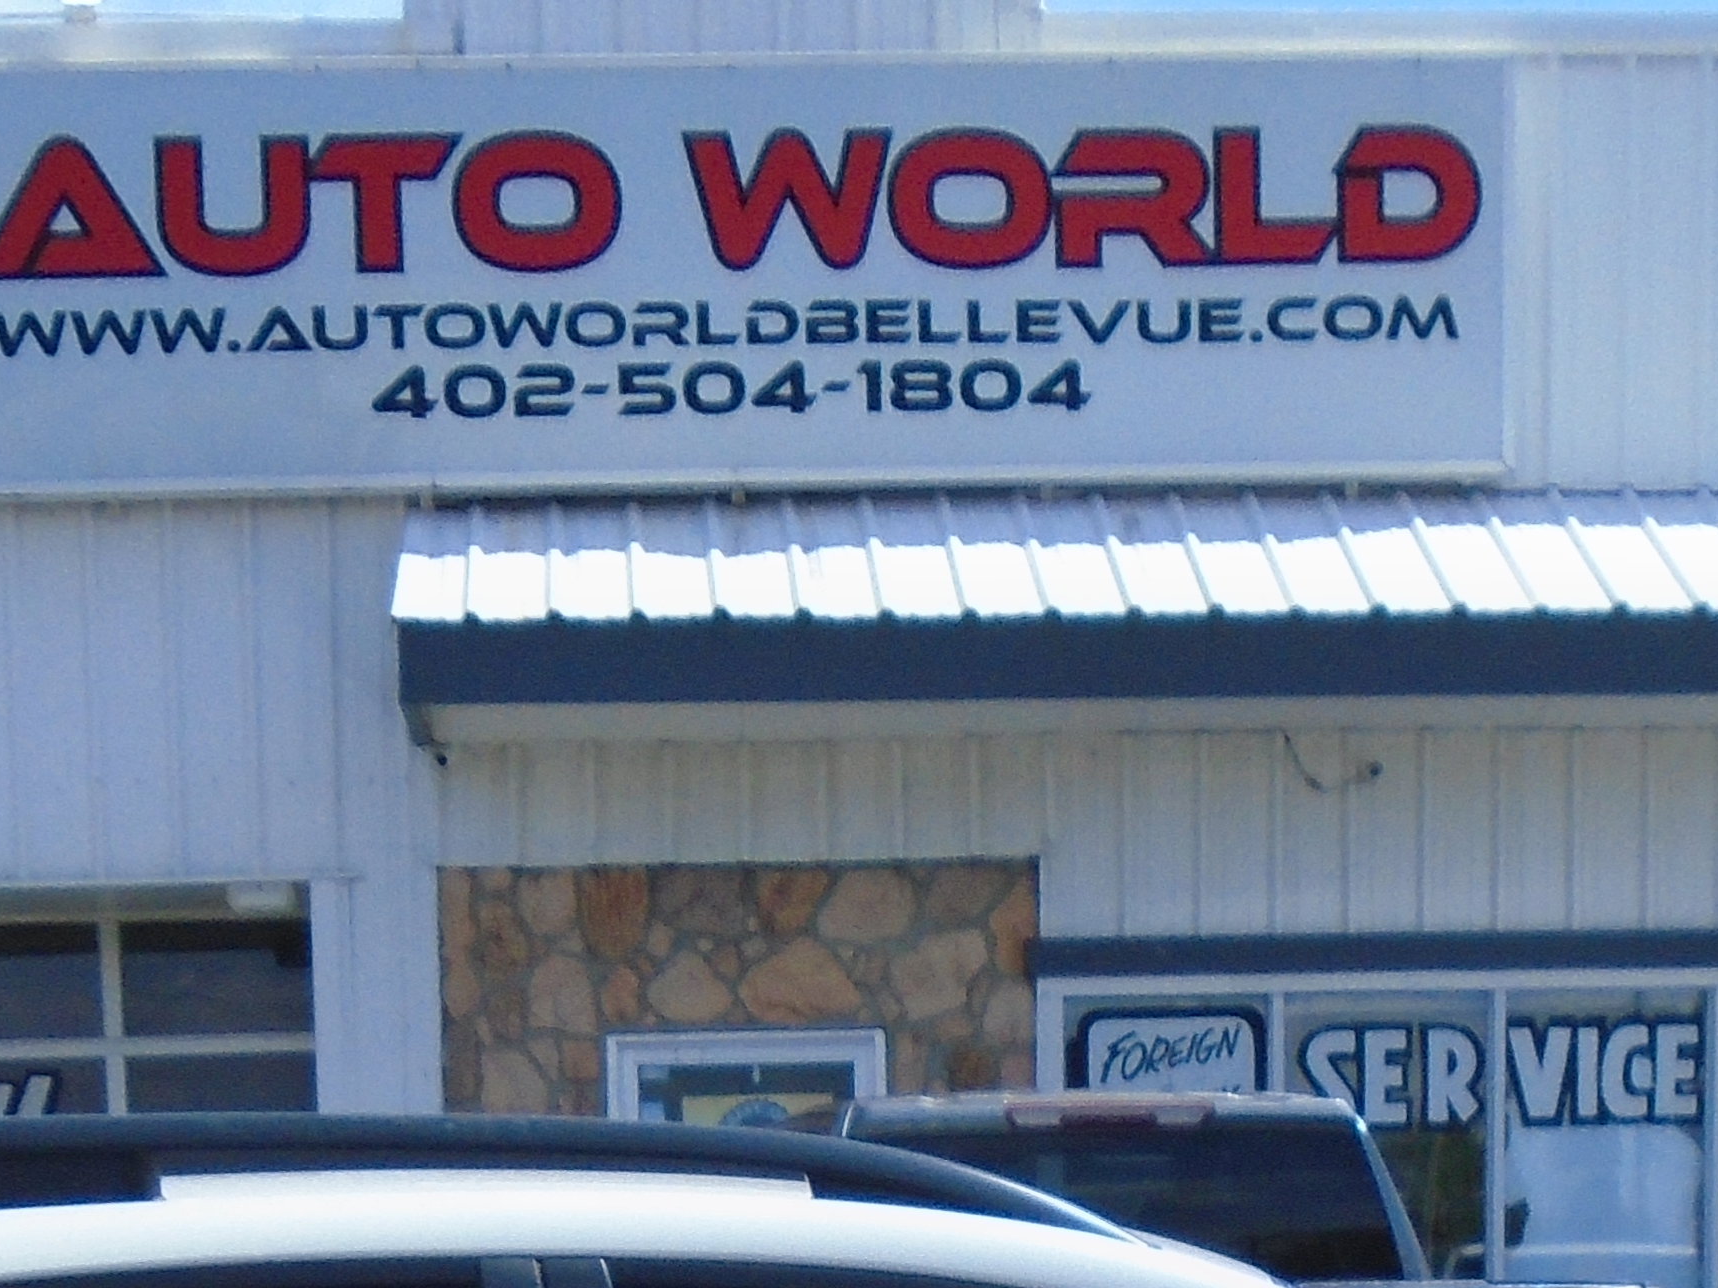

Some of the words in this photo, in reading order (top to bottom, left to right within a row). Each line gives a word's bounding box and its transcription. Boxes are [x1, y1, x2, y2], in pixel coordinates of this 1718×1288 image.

[680, 123, 1482, 272] WORLD
[371, 358, 1094, 420] 402-504-1804
[1099, 1022, 1242, 1084] FOREIGN
[1299, 1016, 1703, 1127] SERVICE
